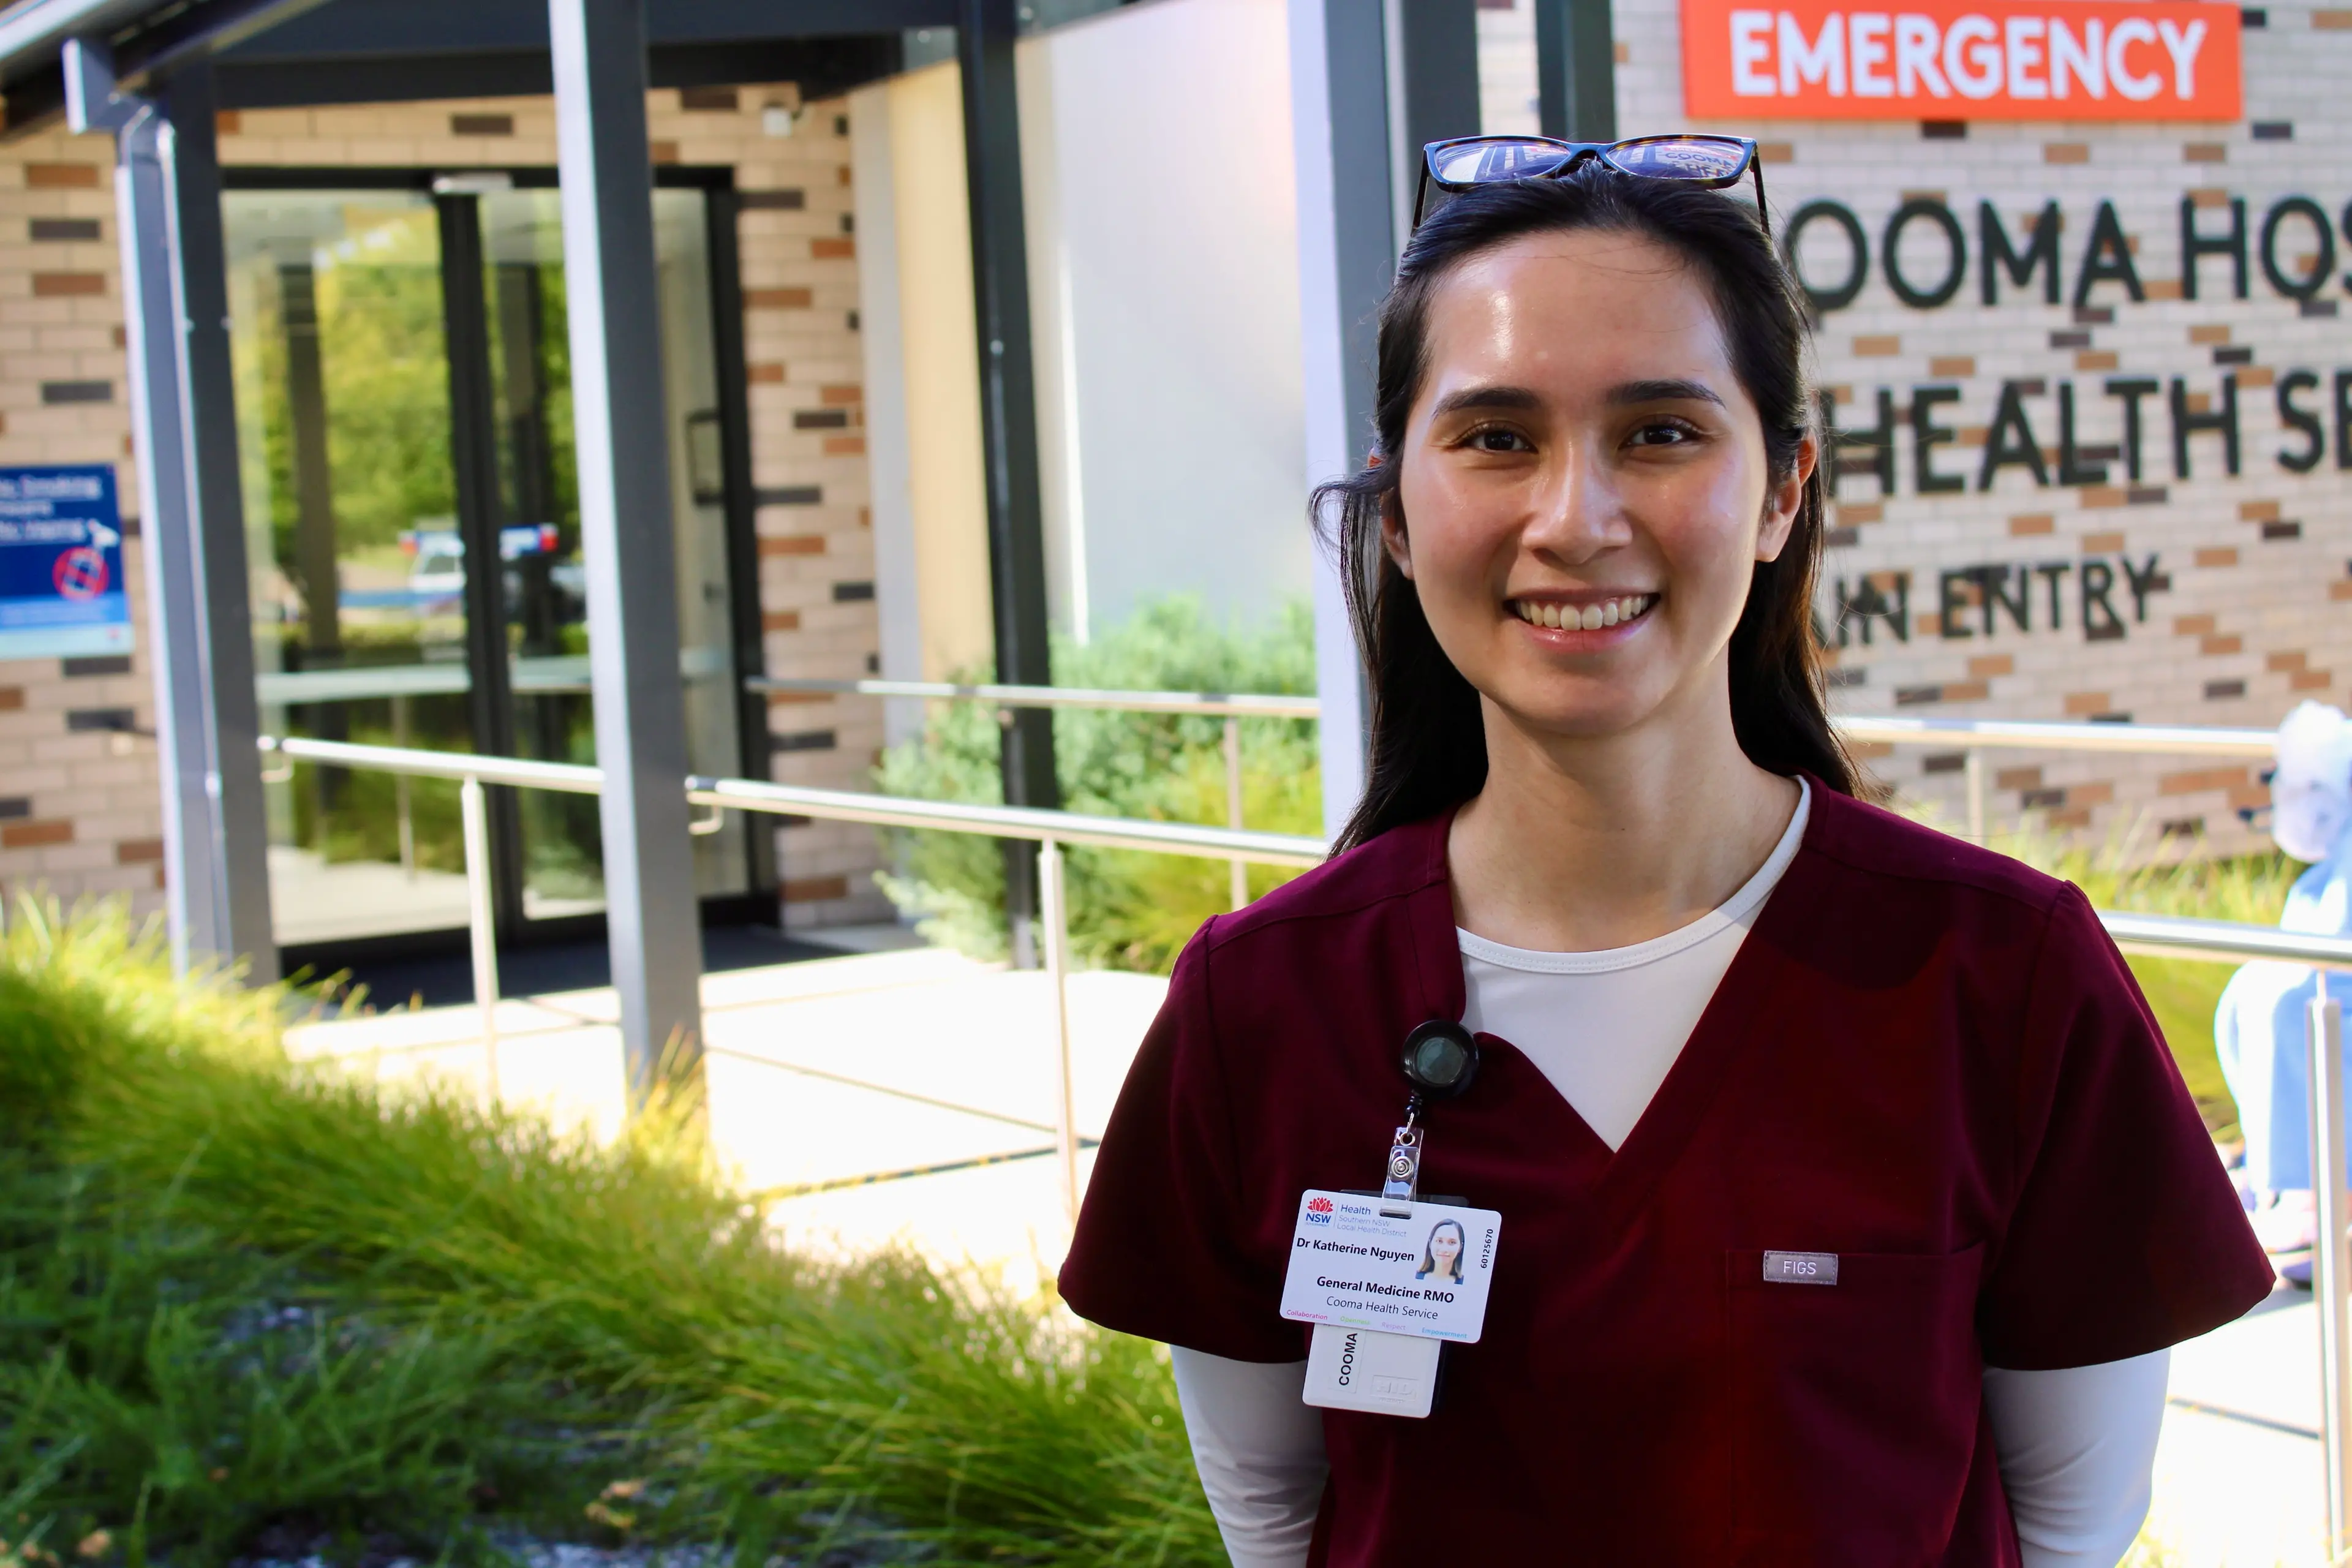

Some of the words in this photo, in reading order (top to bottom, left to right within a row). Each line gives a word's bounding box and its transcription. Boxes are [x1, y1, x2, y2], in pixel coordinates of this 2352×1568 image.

[1730, 10, 2207, 102] EMERGENCY
[1784, 198, 2147, 312] OOMA
[2178, 196, 2352, 301] HO
[1820, 372, 2240, 496] HEALTH
[1940, 553, 2159, 638] ENTRY
[1305, 1212, 1332, 1224] NSW
[1339, 1215, 1371, 1225] Southern
[1340, 1204, 1371, 1215] Health
[1357, 1226, 1380, 1234] Health
[1381, 1229, 1407, 1237] District
[1297, 1237, 1311, 1248] Dr
[1313, 1240, 1368, 1256] Katherine
[1370, 1246, 1415, 1262] Nguyen
[1480, 1229, 1494, 1268] 60125670
[1783, 1260, 1817, 1275] FIGS
[1316, 1276, 1363, 1292] General
[1365, 1282, 1420, 1299] Medicine
[1423, 1290, 1455, 1303] RMO
[1326, 1295, 1363, 1310] Cooma
[1365, 1301, 1400, 1315] Health
[1401, 1306, 1438, 1321] Service
[1286, 1310, 1328, 1321] Collaboration
[1340, 1316, 1371, 1327] Openness
[1381, 1322, 1406, 1331] Respect
[1421, 1327, 1468, 1339] Empowerment
[1339, 1333, 1358, 1386] COOMA
